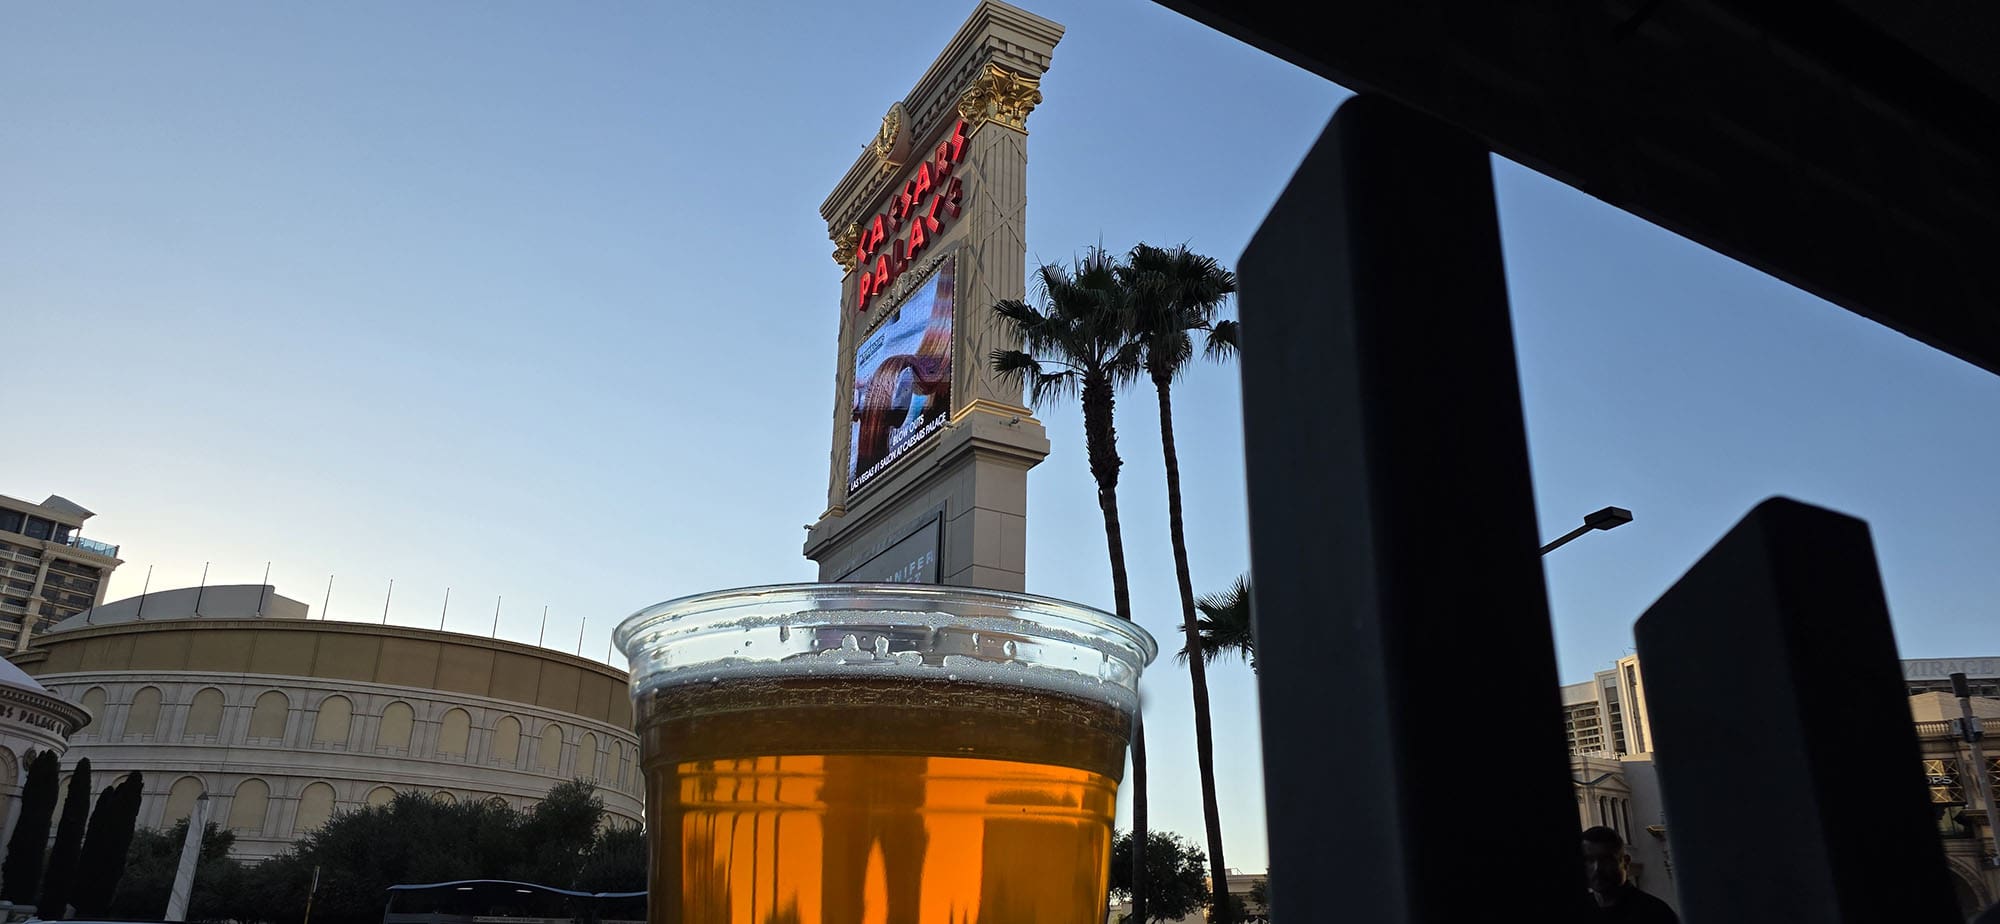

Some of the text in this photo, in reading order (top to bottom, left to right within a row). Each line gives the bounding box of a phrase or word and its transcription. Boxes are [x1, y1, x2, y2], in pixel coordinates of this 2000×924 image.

[856, 118, 970, 266] CAESARS
[858, 175, 963, 312] PALACE
[850, 479, 859, 491] LAS
[859, 466, 875, 484] VEGAS
[880, 450, 897, 469] SALON
[903, 428, 926, 451] CAESARS
[925, 412, 946, 434] PALACE
[893, 413, 924, 446] BLOW OUTS
[18, 710, 56, 731] PALACE
